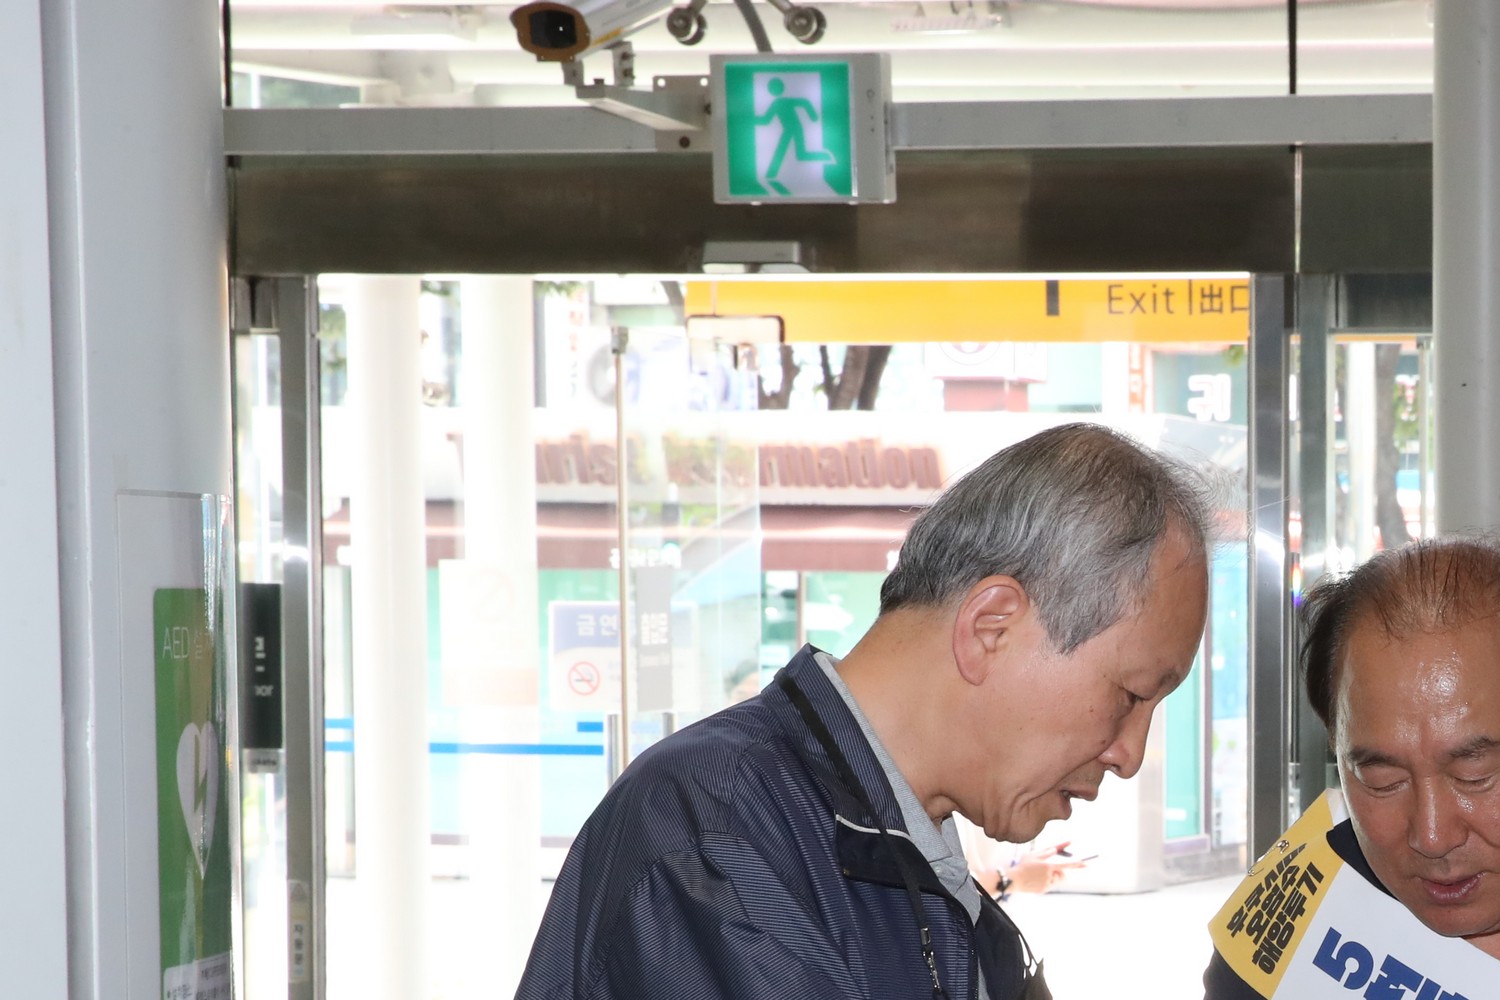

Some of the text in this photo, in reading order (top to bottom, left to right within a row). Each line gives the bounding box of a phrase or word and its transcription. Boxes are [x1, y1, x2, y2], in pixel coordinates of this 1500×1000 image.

[1107, 283, 1174, 315] Exit
[162, 626, 190, 660] AED
[1245, 864, 1300, 946] 오염수
[1252, 861, 1324, 975] 해양투기
